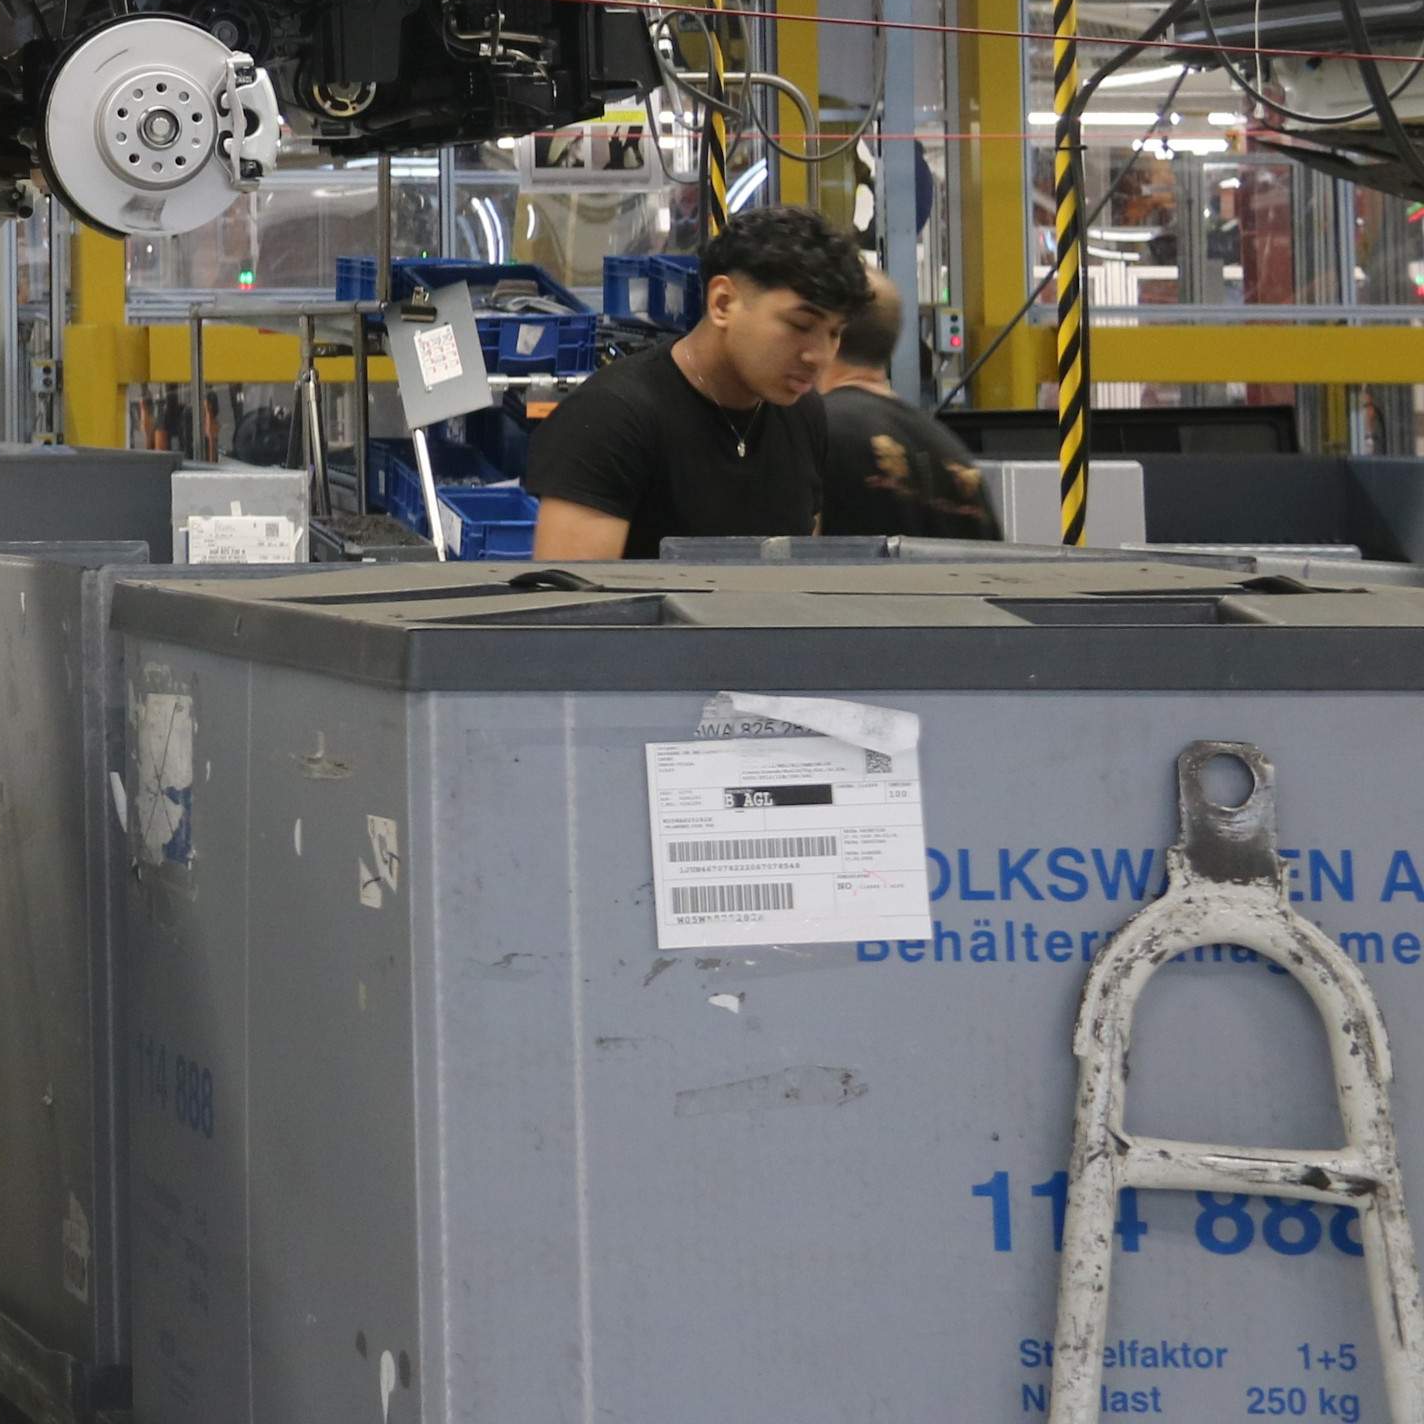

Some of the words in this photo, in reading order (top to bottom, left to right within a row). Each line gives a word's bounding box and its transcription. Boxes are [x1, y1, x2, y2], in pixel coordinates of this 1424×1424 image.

[695, 721, 734, 736] WA
[724, 792, 736, 807] B
[743, 791, 774, 807] AGL
[1019, 1337, 1229, 1371] Stelfaktor
[1297, 1342, 1359, 1372] 1+5
[1022, 1382, 1162, 1415] Nlast
[1247, 1386, 1307, 1417] 250
[1320, 1387, 1361, 1423] kg
